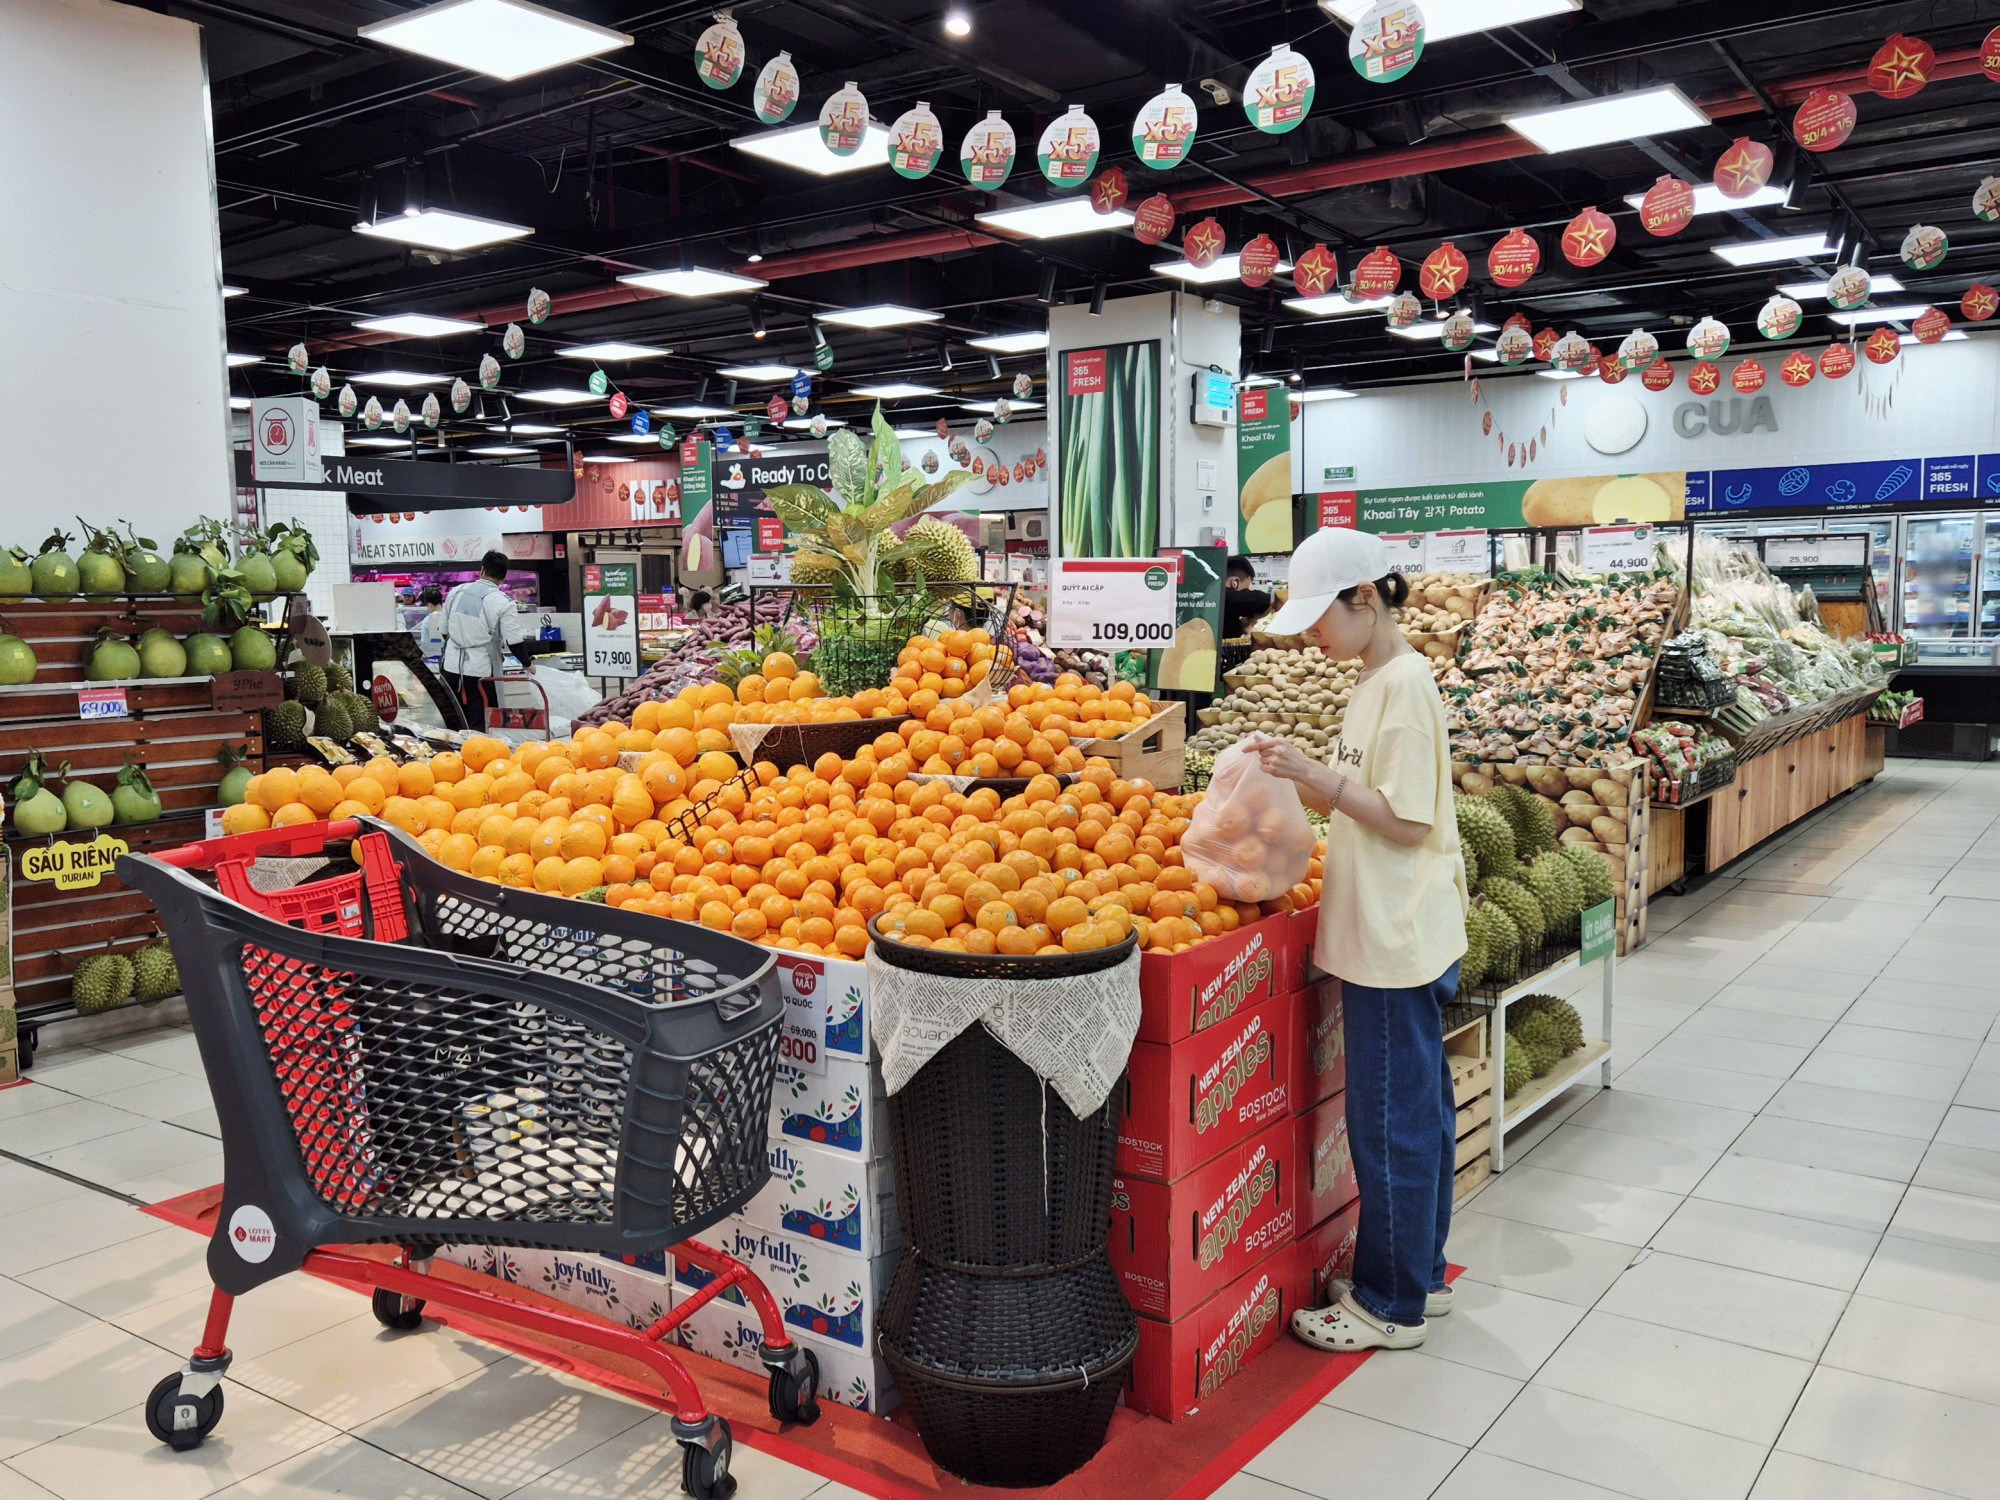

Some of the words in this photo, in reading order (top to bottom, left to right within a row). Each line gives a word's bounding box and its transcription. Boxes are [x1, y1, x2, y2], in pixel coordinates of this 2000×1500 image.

[1073, 366, 1089, 376] 365
[1073, 376, 1101, 387] FRESH
[1672, 395, 1779, 439] CUA
[337, 465, 384, 485] Meat
[752, 465, 795, 486] Ready
[797, 464, 815, 482] To
[1930, 472, 1952, 482] 365
[1930, 483, 1968, 494] FRESH
[631, 478, 681, 521] MEA
[1685, 497, 1705, 506] ESH
[1323, 506, 1339, 515] 365
[1323, 516, 1351, 525] FRESH
[1363, 508, 1396, 520] Khoai
[1398, 507, 1420, 520] Tây
[1449, 505, 1486, 516] Potato
[358, 543, 387, 559] MEAT
[388, 542, 435, 558] STATION
[1789, 556, 1819, 565] 25,900
[1609, 557, 1648, 569] 44,900
[1092, 622, 1173, 643] 109,000
[595, 651, 632, 667] 57,900
[29, 847, 64, 874] SẦU
[62, 871, 94, 883] DURIAN
[1201, 973, 1222, 1006] NEW
[1224, 932, 1263, 981] ZEALAND
[1197, 948, 1269, 1031] apples
[792, 997, 813, 1009] QUỐC
[1316, 1010, 1336, 1040] NEW
[1199, 1060, 1221, 1094] NEW
[1221, 1015, 1262, 1066] ZEALAND
[1196, 1031, 1269, 1135] apples
[1239, 1083, 1287, 1123] BOSTOCK
[1118, 1135, 1163, 1152] BOSTOCK
[1317, 1131, 1336, 1162] NEW
[1203, 1198, 1225, 1230] NEW
[1225, 1145, 1267, 1200] ZEALAND
[1200, 1158, 1276, 1271] apples
[248, 1228, 271, 1236] LOTTE
[249, 1235, 271, 1244] MART
[1245, 1207, 1293, 1253] BOSTOCK
[732, 1228, 801, 1273] joyfully
[553, 1256, 612, 1295] joyfully
[770, 1263, 791, 1275] grown
[1319, 1254, 1338, 1283] NEW
[1124, 1272, 1165, 1289] BOSTOCK
[1204, 1331, 1226, 1366] NEW
[1227, 1274, 1269, 1335] ZEALAND
[1201, 1288, 1279, 1401] apples
